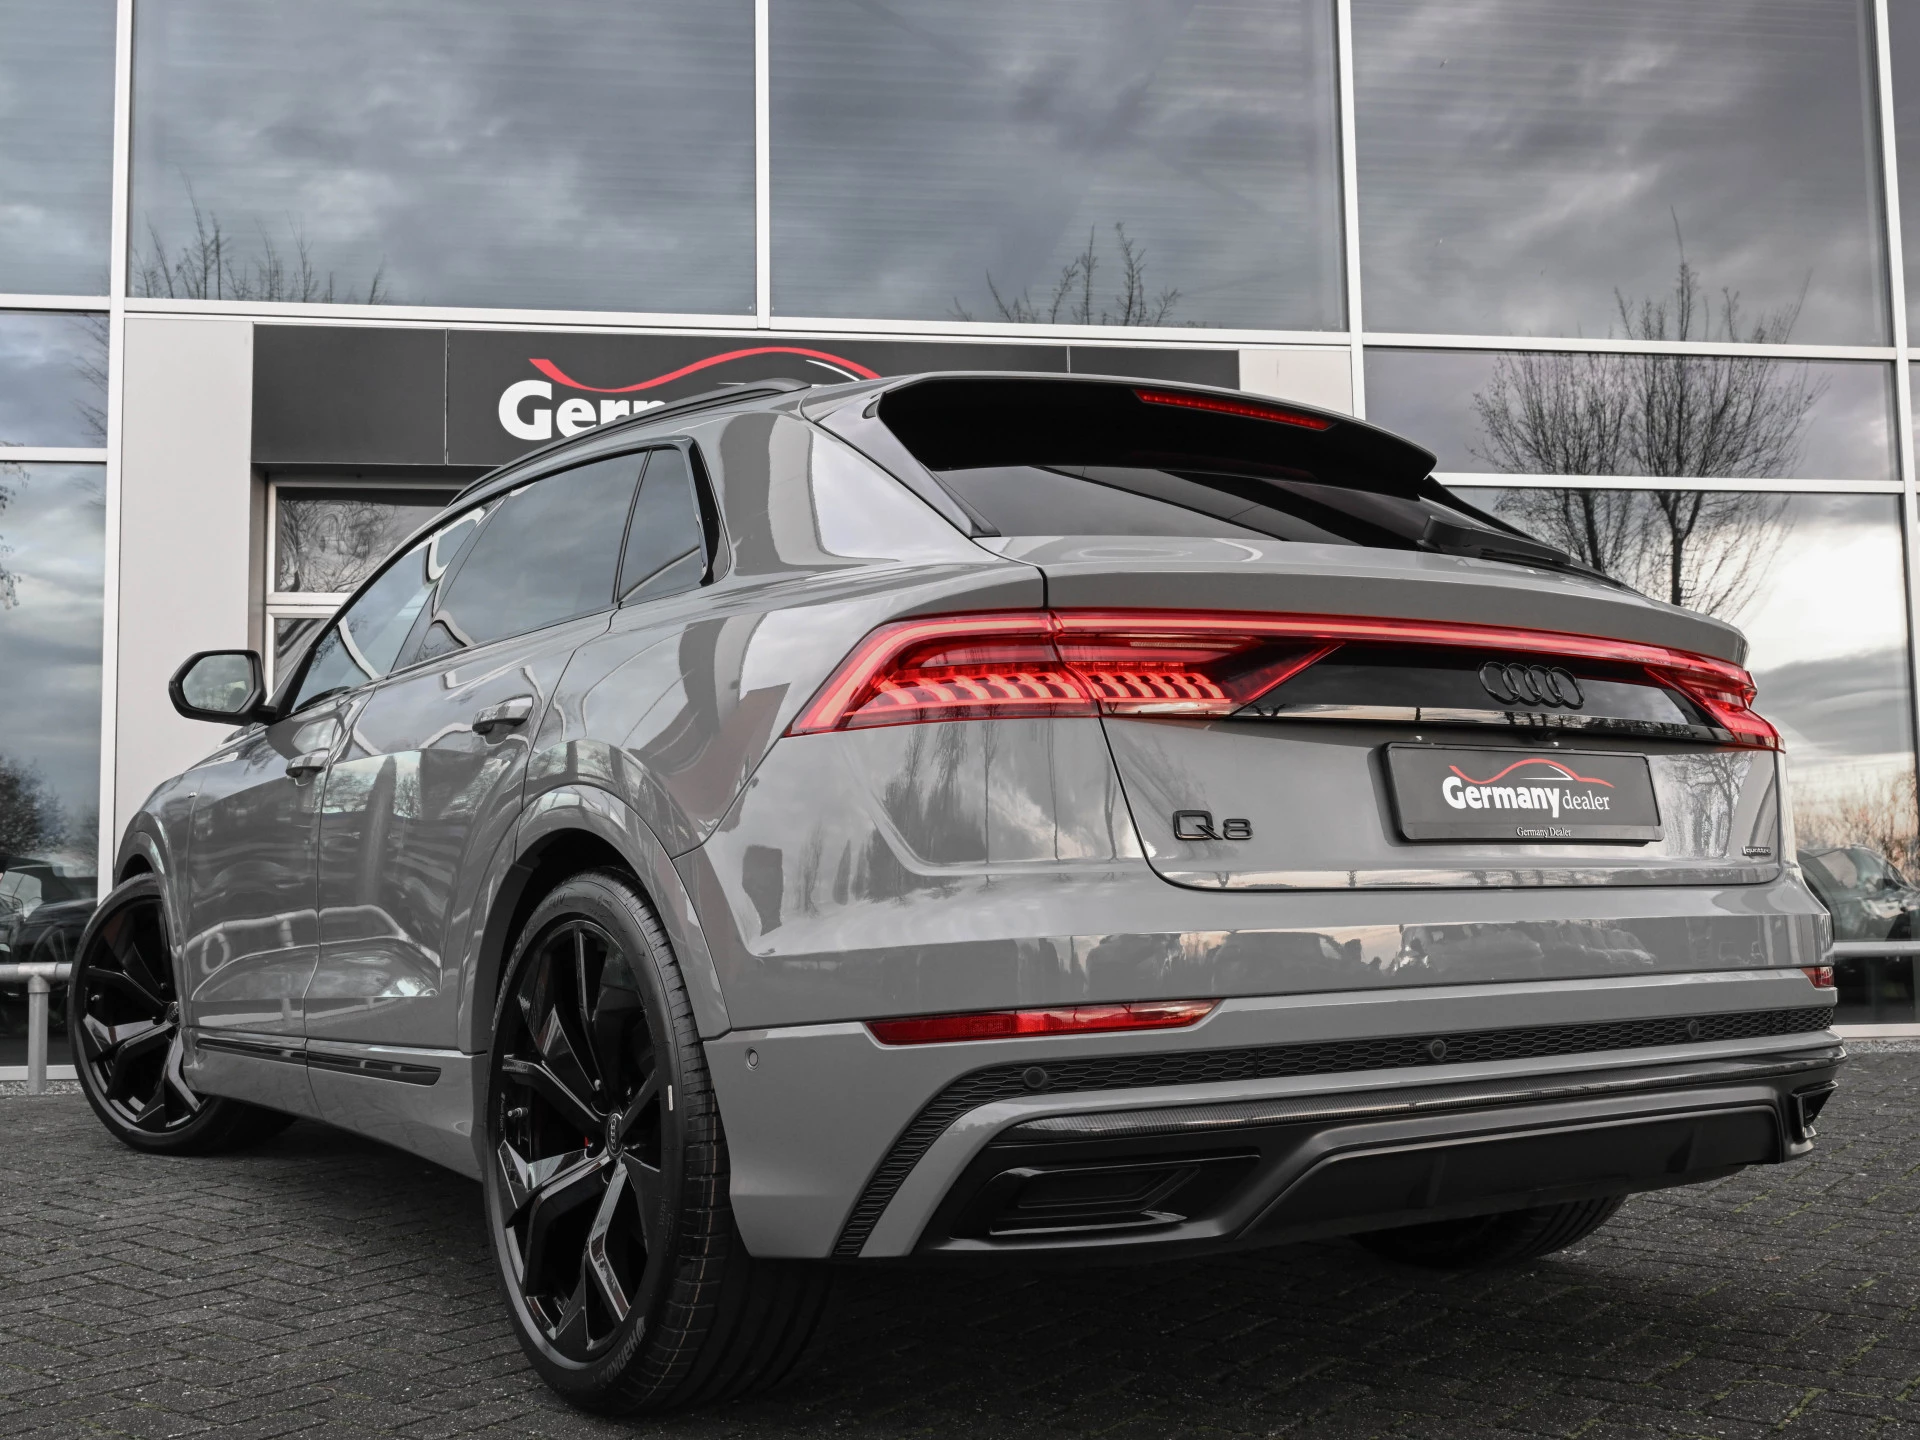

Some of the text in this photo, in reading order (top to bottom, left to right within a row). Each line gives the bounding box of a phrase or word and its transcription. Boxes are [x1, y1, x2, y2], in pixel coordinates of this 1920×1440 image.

[498, 379, 666, 441] Ger
[1441, 776, 1611, 819] Germany dealer
[1172, 809, 1254, 841] Q8
[1516, 826, 1572, 839] Germany Dealer
